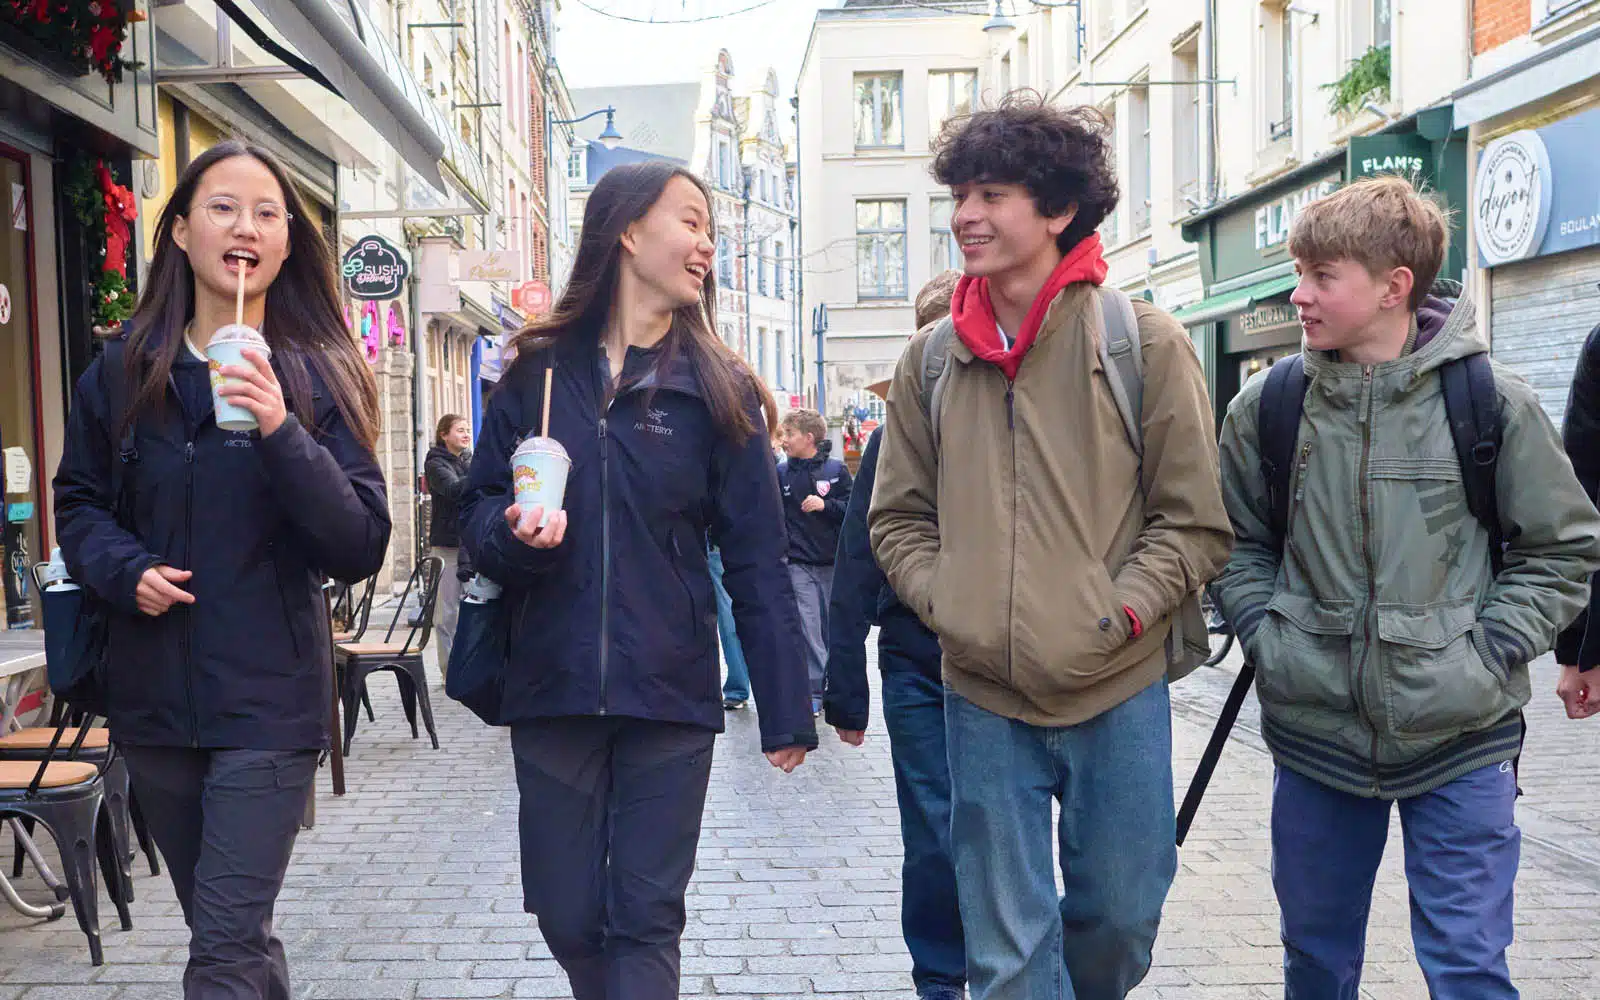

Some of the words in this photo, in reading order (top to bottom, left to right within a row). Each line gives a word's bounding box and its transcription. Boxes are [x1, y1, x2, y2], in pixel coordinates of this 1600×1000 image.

[1362, 155, 1424, 172] FLAM'S
[1479, 163, 1541, 229] dupont
[364, 264, 404, 276] SUSHI
[356, 273, 393, 285] Delivery
